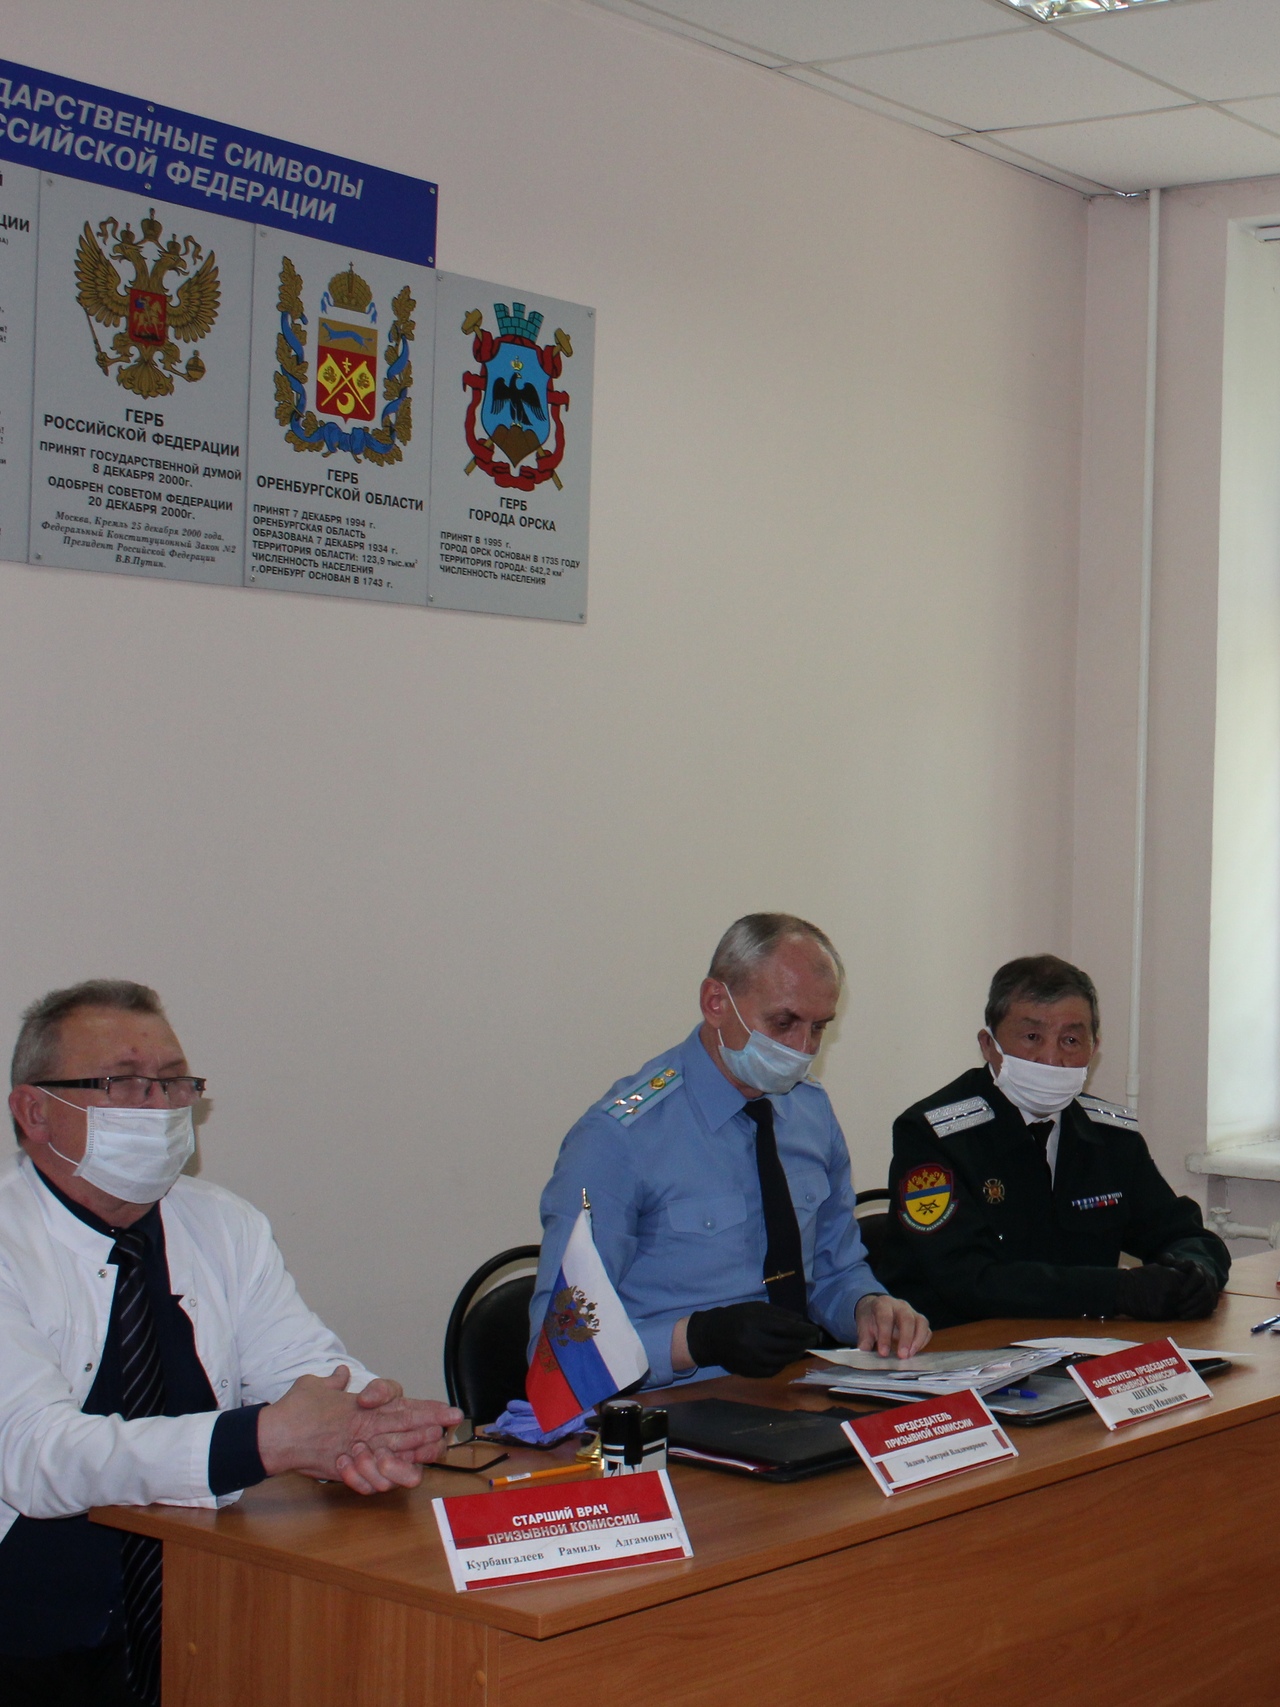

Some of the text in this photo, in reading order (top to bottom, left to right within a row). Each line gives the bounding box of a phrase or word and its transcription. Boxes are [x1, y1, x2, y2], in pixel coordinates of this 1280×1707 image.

[225, 142, 364, 200] СИМВОЛЫ
[166, 160, 337, 224] ФЕДЕРАЦИИ
[125, 408, 164, 427] ГЕРБ
[44, 414, 240, 457] РОССИЙСКОЙ ФЕДЕРАЦИИ
[40, 441, 241, 480] ПРИНЯТ ГОСУДАРСТВЕННОЙ ДУМОЙ
[93, 464, 193, 487] 8 ДЕКАБРЯ 2000г.
[328, 469, 358, 484] ГЕРБ
[48, 476, 233, 511] ОДОБРЕН СОВЕТОМ ФЕДЕРАЦИИ
[257, 476, 424, 511] ОРЕНБУРГСКОЙ ОБЛАСТИ
[500, 497, 528, 511] ГЕРБ
[88, 496, 195, 519] 20 ДЕКАБРЯ 2000г.
[253, 504, 290, 517] ПРИНЯТ
[293, 510, 298, 518] 7
[302, 511, 342, 524] ДЕКАБРЯ
[345, 518, 366, 527] 1994
[95, 516, 128, 529] Кремль
[131, 522, 141, 530] 25
[144, 521, 178, 536] декабря
[182, 529, 202, 538] 2000
[253, 516, 366, 538] ОРЕНБУРГСКАЯ ОБЛАСТЬ
[469, 509, 556, 531] ГОРОДА ОРСКА
[41, 521, 103, 537] Федеральный
[107, 530, 192, 548] Конституционный
[195, 541, 220, 551] Закон
[253, 528, 314, 543] ОБРАЗОВАНА
[317, 536, 322, 544] 7
[325, 538, 365, 550] ДЕКАБРЯ
[368, 544, 388, 553] 1934
[441, 531, 472, 543] ПРИНЯТ
[484, 538, 502, 547] 1995
[63, 536, 216, 563] Президент Российской Федерации
[253, 541, 312, 555] ТЕРРИТОРИЯ
[315, 549, 359, 561] ОБЛАСТИ:
[362, 555, 385, 565] 123,9
[440, 542, 468, 554] ГОРОД
[471, 547, 491, 556] ОРСК
[494, 550, 531, 561] ОСНОВАН
[541, 556, 559, 565] 1735
[561, 559, 580, 568] ГОДУ
[252, 552, 374, 574] ЧИСЛЕННОСТЬ НАСЕЛЕНИЯ
[440, 554, 492, 567] ТЕРРИТОРИЯ
[494, 561, 527, 572] ГОРОДА:
[530, 566, 550, 576] 642,2
[252, 565, 306, 577] г.ОРЕНБУРГ
[309, 572, 351, 583] ОСНОВАН
[363, 577, 383, 587] 1743
[440, 565, 546, 585] ЧИСЛЕННОСТЬ НАСЕЛЕНИЯ
[1092, 1357, 1179, 1388] ЗАМЕСТИТЕЛЬ ПРЕДСЕДАТЕЛЯ
[1108, 1368, 1178, 1395] ПРИЗЫВНОЙ КОМИССИИ
[1132, 1383, 1168, 1400] ШЕЙБАК
[1128, 1394, 1188, 1416] Виктор Иванович
[885, 1418, 974, 1449] ПРИЗЫВНОЙ КОМИССИИ
[894, 1412, 952, 1433] ПРЕДСЕДАТЕЛЬ
[926, 1450, 950, 1463] Дмитрий
[950, 1441, 988, 1456] Владимирович
[512, 1504, 609, 1526] СТАРШИЙ ВРАЧ
[570, 1513, 640, 1533] КОМИССИИ
[466, 1532, 674, 1572] Курбангалеев Рамиль Адгамович
